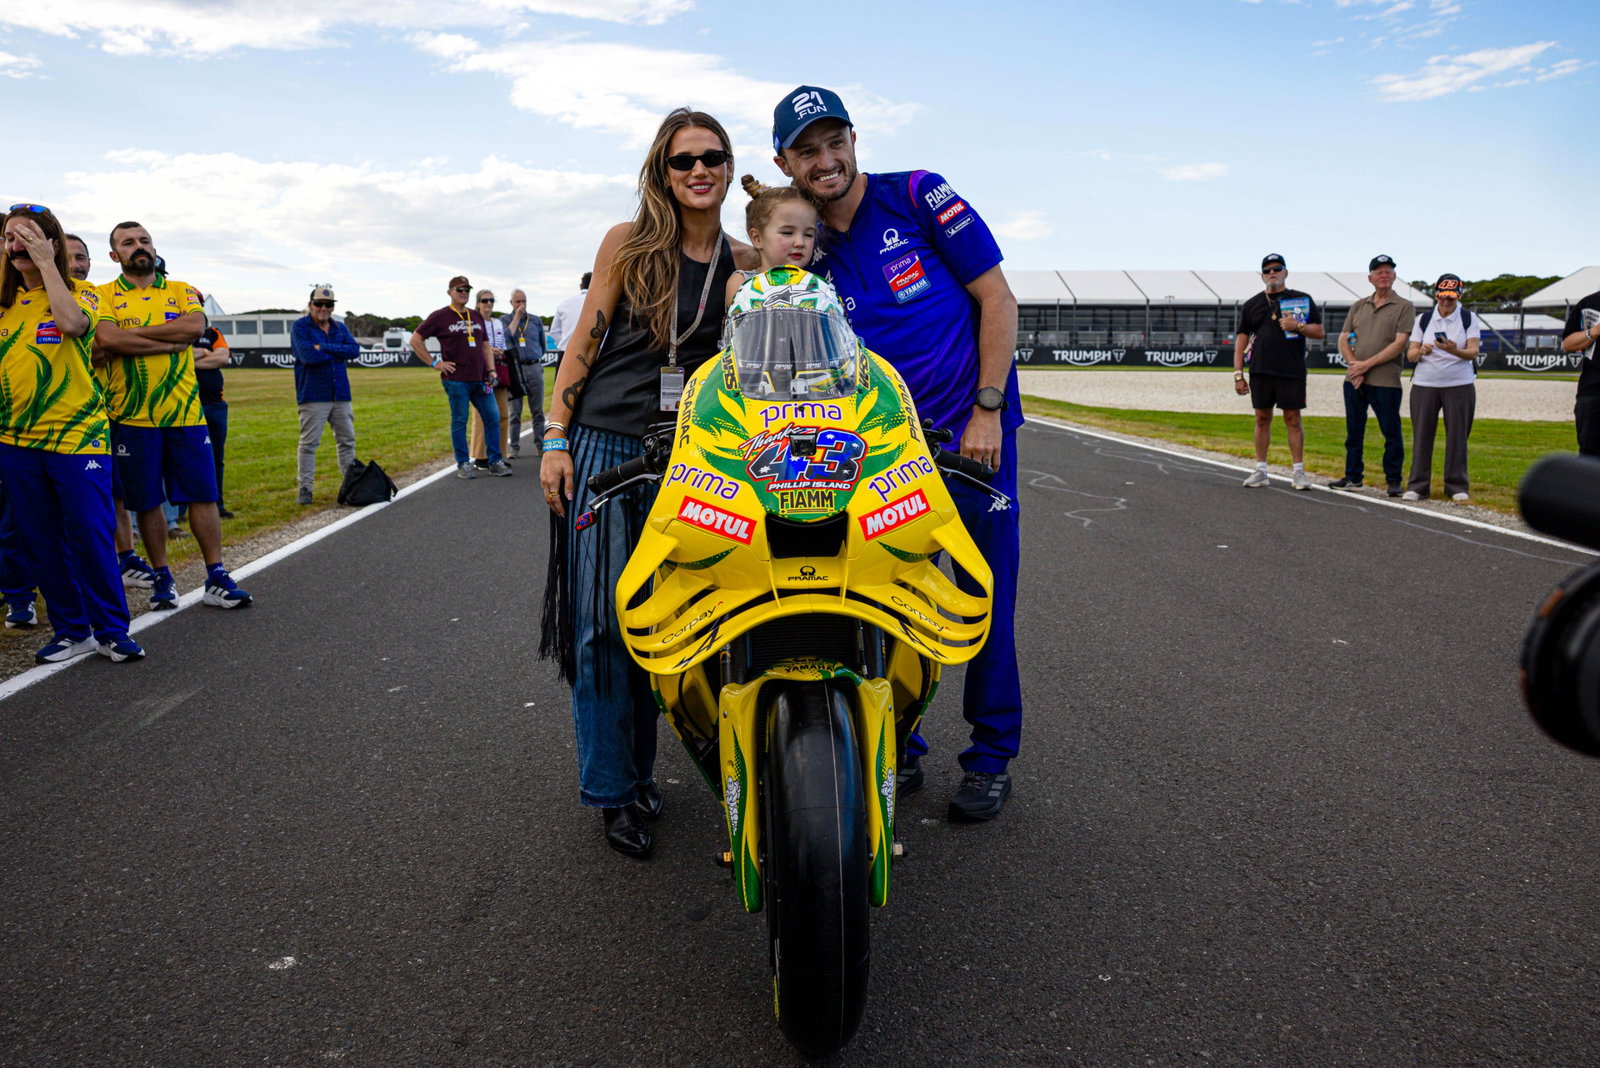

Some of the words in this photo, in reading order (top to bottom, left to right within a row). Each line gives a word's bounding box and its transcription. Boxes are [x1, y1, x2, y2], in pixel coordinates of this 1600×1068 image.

[792, 91, 824, 113] 21
[940, 203, 964, 223] MOTUL
[879, 239, 909, 255] PRAMAC
[890, 257, 912, 274] prima
[903, 278, 929, 297] YAMAHA
[1052, 350, 1112, 366] TRIUMPH
[1144, 351, 1205, 367] TRIUMPH
[1505, 354, 1568, 371] TRIUMPH
[679, 377, 697, 449] PRAMAC
[759, 402, 842, 428] prima
[893, 373, 921, 443] PRAMAC
[747, 428, 867, 482] 43
[666, 463, 740, 500] prima
[768, 481, 809, 491] PHILLIP
[811, 481, 851, 490] ISLAND
[868, 456, 933, 502] prima
[780, 490, 834, 509] FIAMM
[680, 501, 749, 540] MOTUL
[866, 494, 927, 536] MOTUL
[661, 605, 716, 644] Corpay
[891, 596, 943, 632] Corpay
[784, 662, 834, 673] YAMAHA
